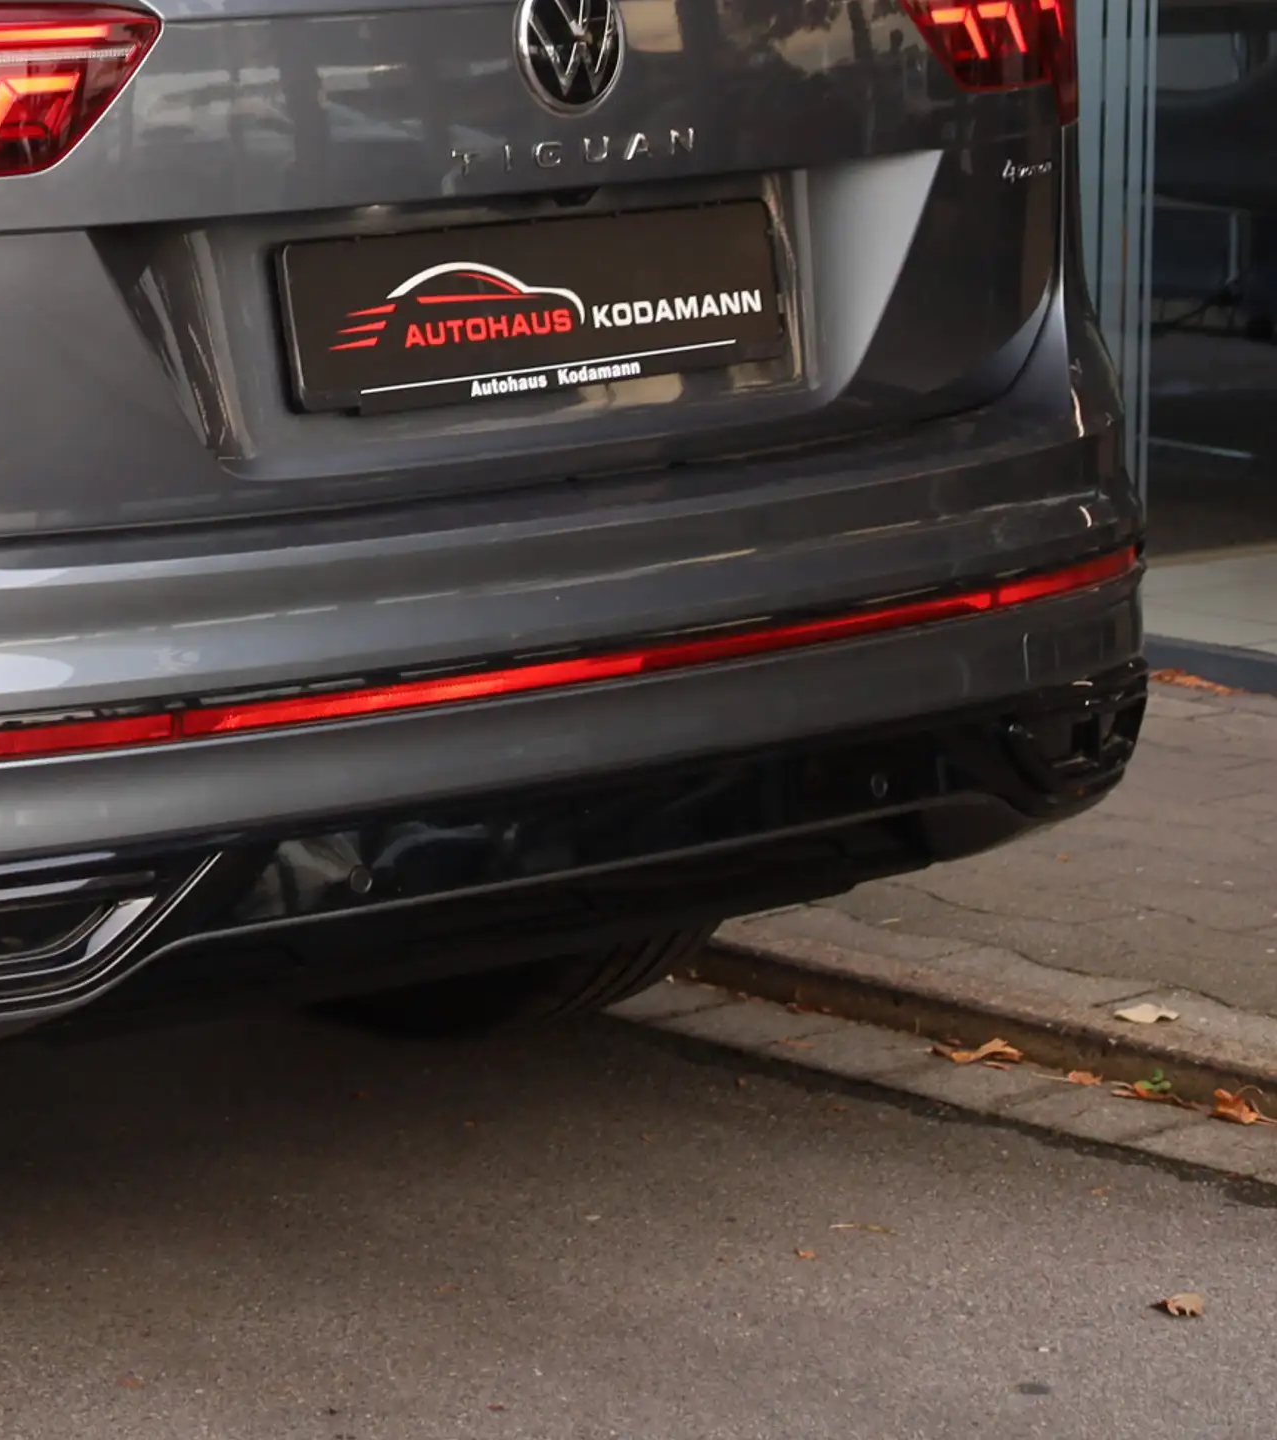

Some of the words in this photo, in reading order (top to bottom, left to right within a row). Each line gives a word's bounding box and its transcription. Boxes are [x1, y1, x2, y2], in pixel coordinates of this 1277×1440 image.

[450, 127, 695, 176] TIGUAN
[404, 308, 573, 348] AUTOHAUS
[592, 289, 763, 328] KODAMANN
[470, 372, 547, 397] Autohaus
[557, 361, 642, 385] Kodamann
